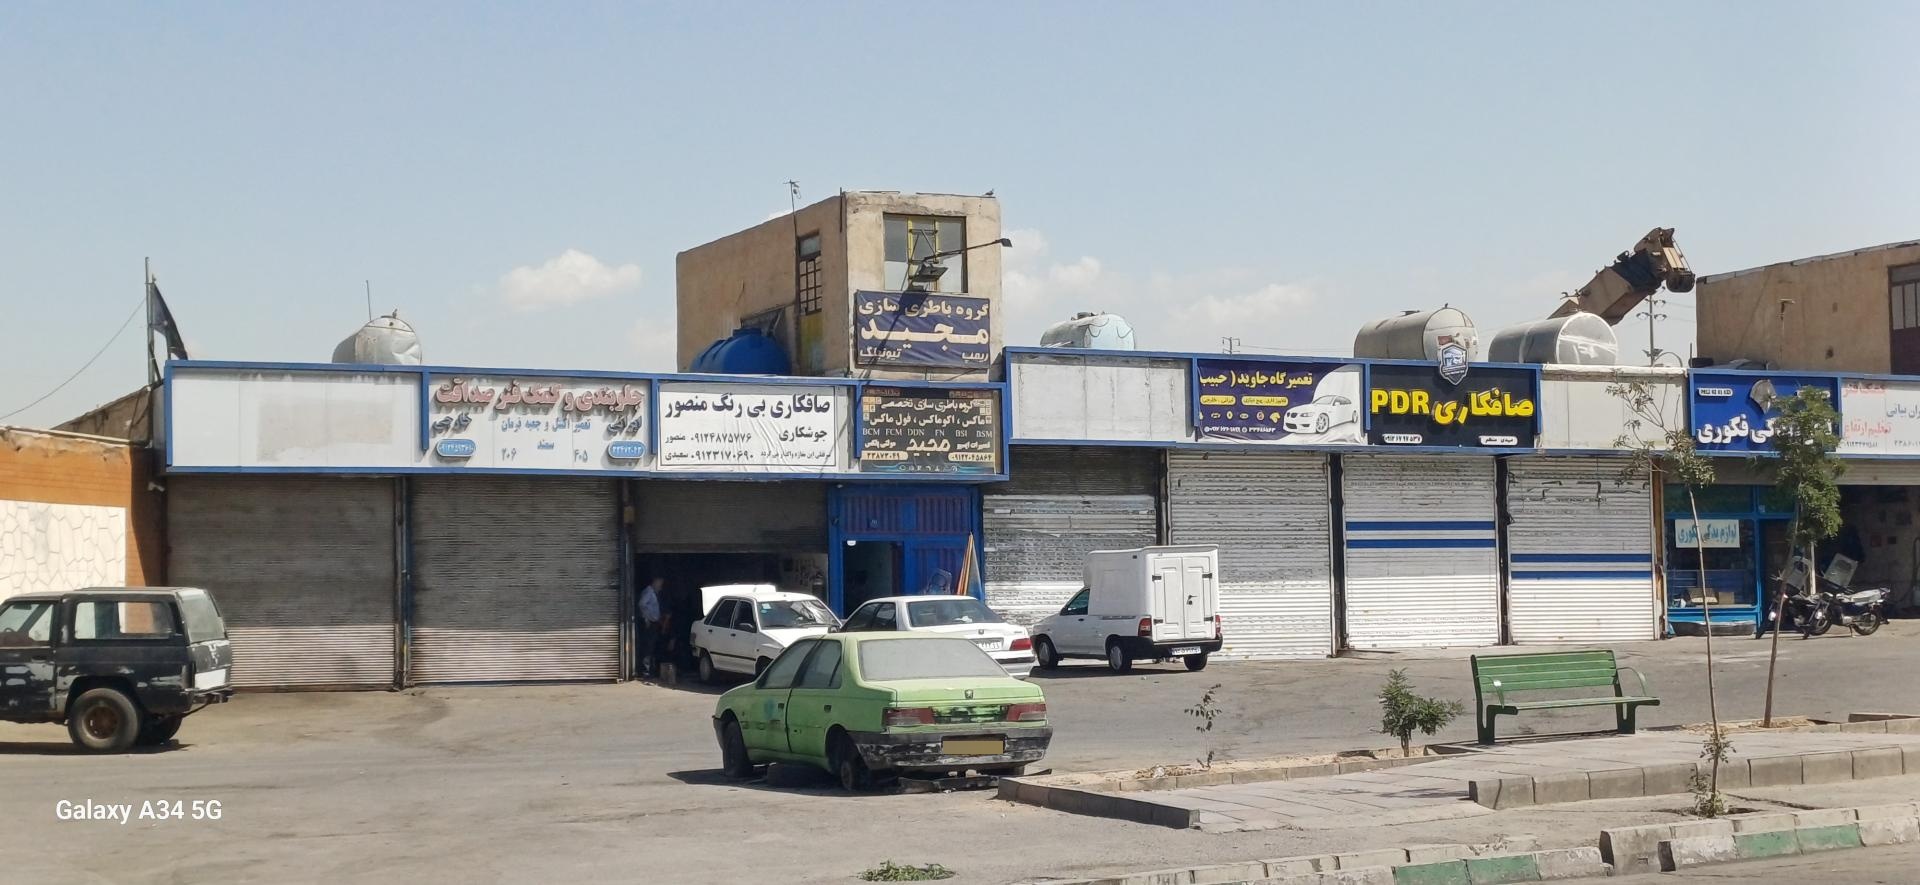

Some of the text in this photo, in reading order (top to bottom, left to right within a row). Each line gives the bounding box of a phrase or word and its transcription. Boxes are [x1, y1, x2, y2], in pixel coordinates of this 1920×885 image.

[858, 298, 989, 321] گروه باطری سازی
[861, 318, 989, 351] مجید
[1237, 370, 1269, 388] جاوید
[436, 377, 645, 412] جلوبندی و کمک فنر صداقت
[664, 392, 831, 419] صافکاری بی رنگ منصور
[1371, 387, 1534, 425] صافکاری PDR
[869, 413, 894, 425] ماکس
[895, 413, 911, 425] فول
[961, 416, 985, 428] ماکس
[1698, 413, 1749, 444] فکوری
[779, 426, 828, 442] جوشکاری
[906, 438, 951, 457] مجید
